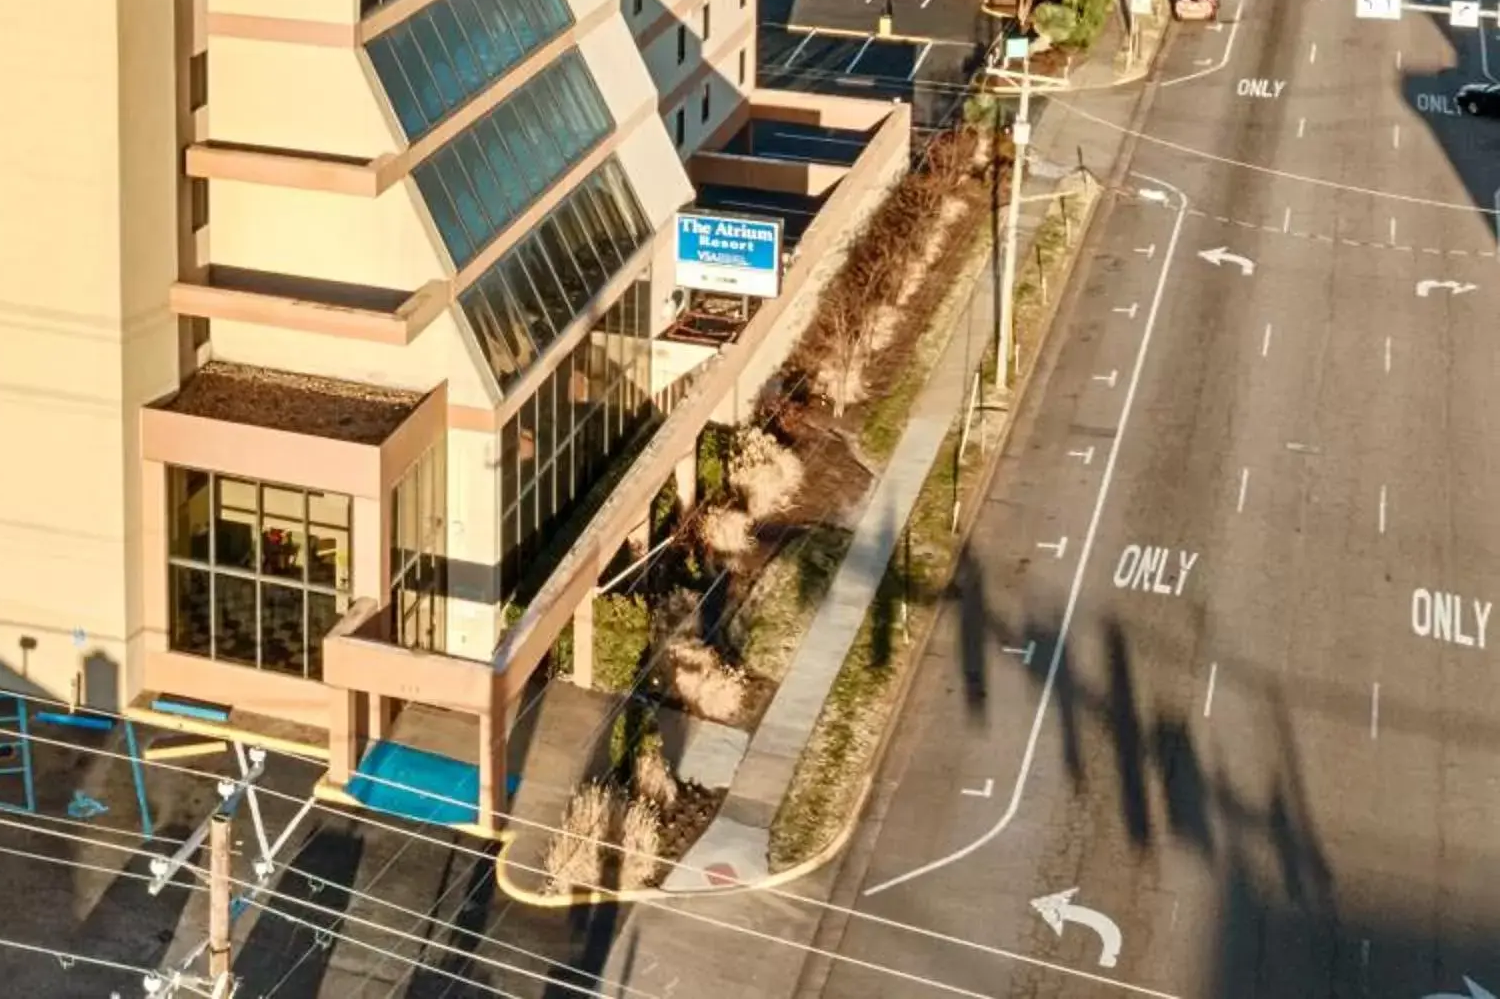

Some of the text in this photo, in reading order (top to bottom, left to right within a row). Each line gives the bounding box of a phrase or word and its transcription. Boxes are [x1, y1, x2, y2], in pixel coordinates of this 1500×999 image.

[1237, 78, 1288, 98] ONLY
[683, 218, 773, 242] The Atrium
[699, 236, 754, 252] Resort
[1113, 544, 1199, 596] ONLY
[1412, 588, 1493, 649] ONLY
